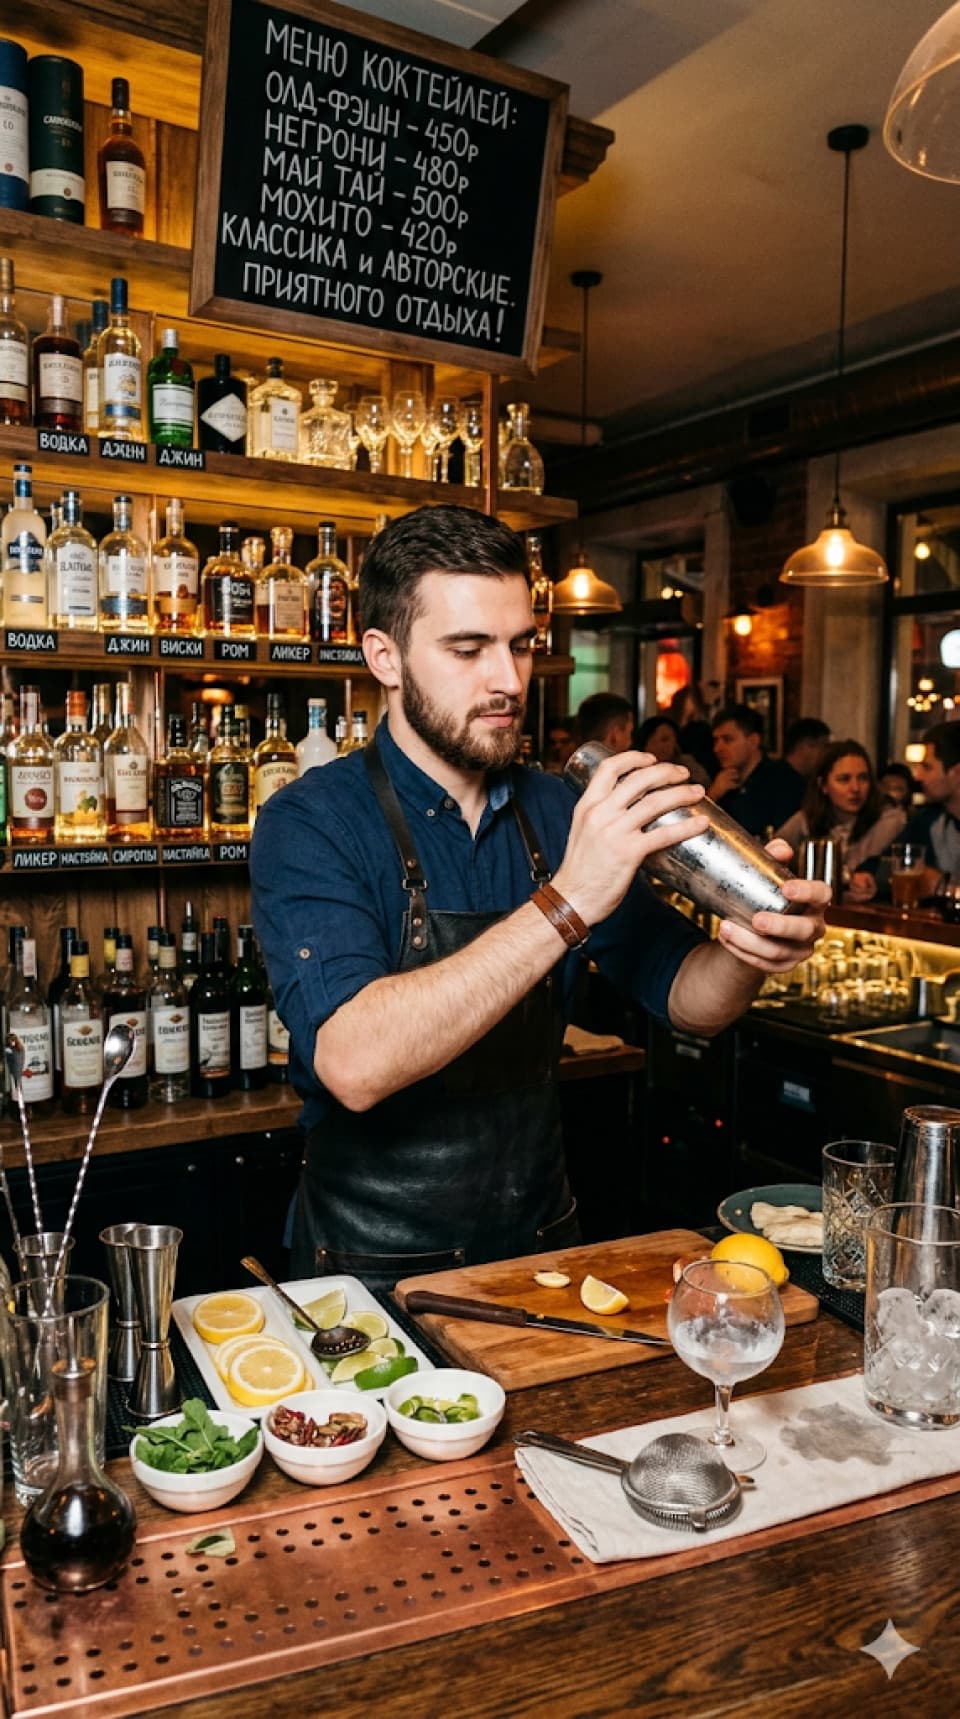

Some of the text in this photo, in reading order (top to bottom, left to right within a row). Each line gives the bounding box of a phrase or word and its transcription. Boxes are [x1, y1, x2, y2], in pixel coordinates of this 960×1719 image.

[265, 18, 518, 130] МЕНЮ КОКТЕЙЛЕЙ:
[265, 71, 400, 138] ОЛД-ФЭШН
[265, 109, 386, 171] НЕГРОНИ
[263, 147, 323, 190] МАЙ
[334, 163, 385, 205] ТАЙ
[260, 183, 372, 237] МОХИТО
[221, 211, 347, 271] КЛАССИКА
[381, 249, 516, 307] АВТОРСКИЕ.
[243, 262, 506, 343] ПРИЯТНОГО ОТДЫХА!
[40, 432, 88, 453] ВОДКА
[159, 451, 203, 468] ДЖИН
[8, 632, 56, 650] ВОДКА
[107, 637, 151, 653] ДЖИН
[160, 640, 202, 656] ВИСКИ
[221, 643, 250, 658] РОМ
[271, 646, 311, 661] ЛИКЕР
[14, 850, 58, 867] ЛИКЕР
[113, 849, 157, 863] СИРОПЫ
[220, 845, 247, 859] РОМ
